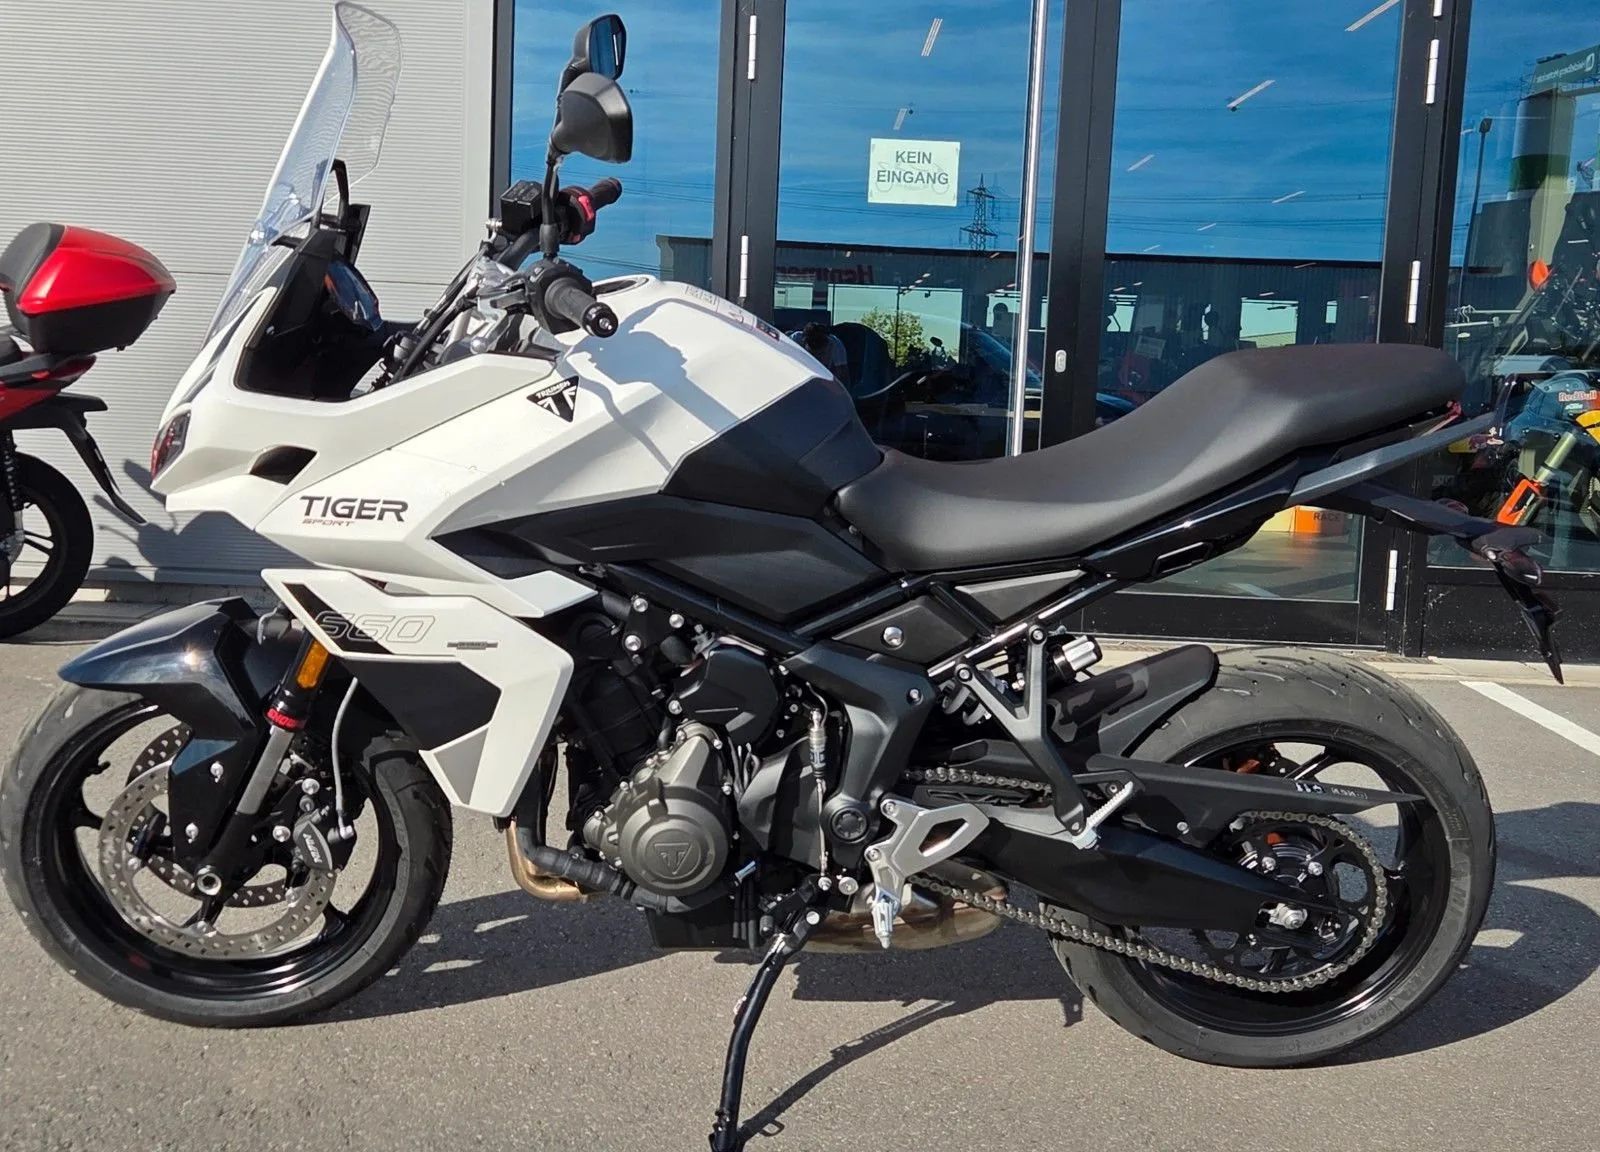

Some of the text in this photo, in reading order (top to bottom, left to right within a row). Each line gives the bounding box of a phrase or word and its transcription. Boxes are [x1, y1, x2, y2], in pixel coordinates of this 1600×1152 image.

[895, 150, 932, 164] KEIN
[876, 169, 949, 185] EINGANG
[535, 380, 571, 399] TRIUMPH
[300, 495, 409, 522] TIGER
[302, 518, 354, 527] SPORT
